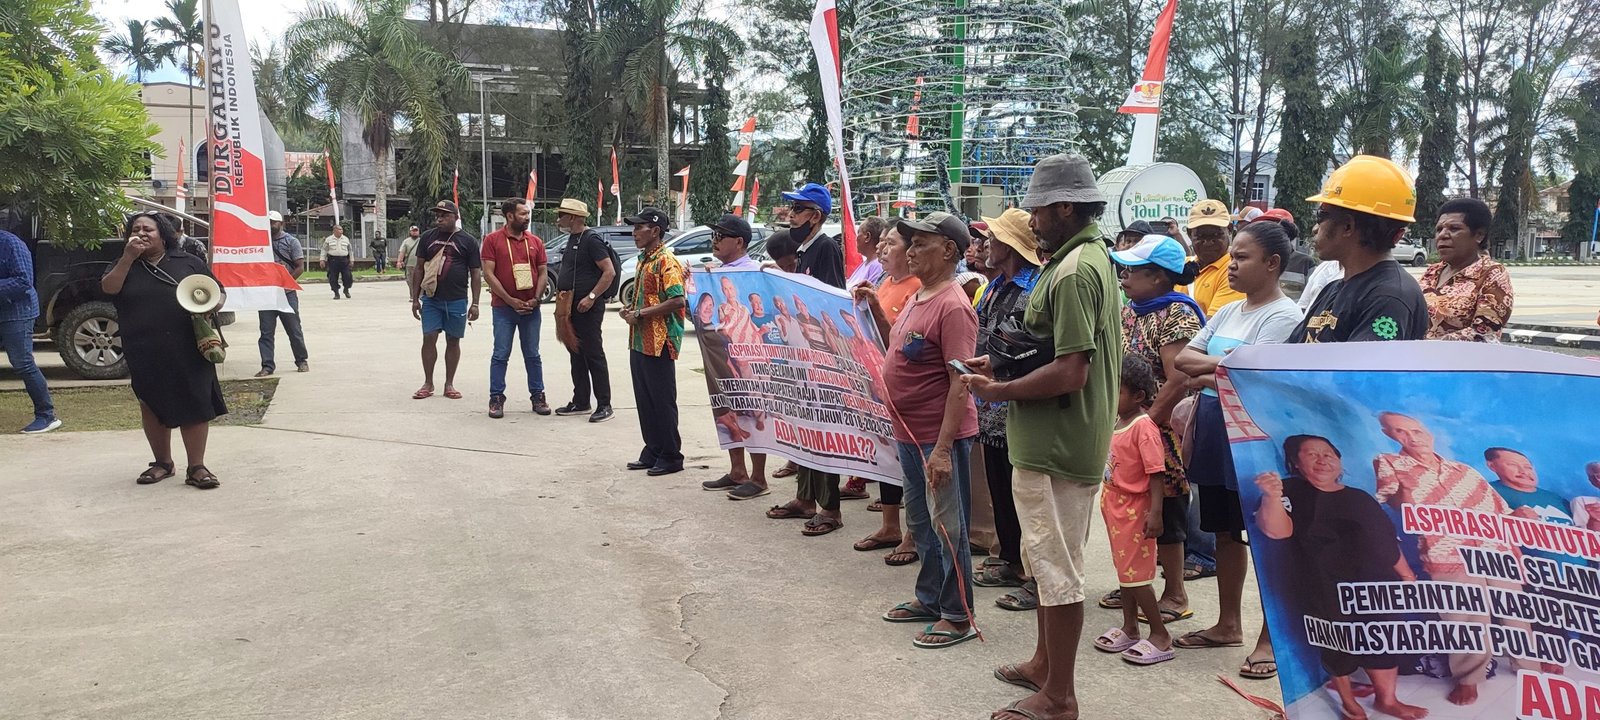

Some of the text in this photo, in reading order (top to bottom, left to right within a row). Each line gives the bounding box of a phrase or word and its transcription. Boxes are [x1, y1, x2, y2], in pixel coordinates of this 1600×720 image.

[211, 24, 231, 194] DIRGAHAYU
[223, 34, 243, 185] REPUBLIK INDONESIA
[1131, 203, 1193, 218] Idul Fitr
[718, 381, 760, 391] EMERINTAH
[797, 386, 817, 401] RAJA
[820, 390, 845, 404] AMPAT
[750, 363, 769, 375] YANG
[770, 364, 796, 380] SELAMA
[796, 367, 807, 381] INI
[785, 403, 798, 417] GAG
[799, 408, 814, 421] DARI
[815, 409, 843, 424] TAHUN
[775, 420, 875, 460] ADA DIMANA??
[1460, 547, 1600, 597] YANG SELAM
[1340, 583, 1600, 635] PEMERINTAH KABUPATE
[1305, 617, 1336, 648] HAK
[1332, 622, 1484, 652] MASYARAKAT
[1489, 626, 1567, 664] PULAU
